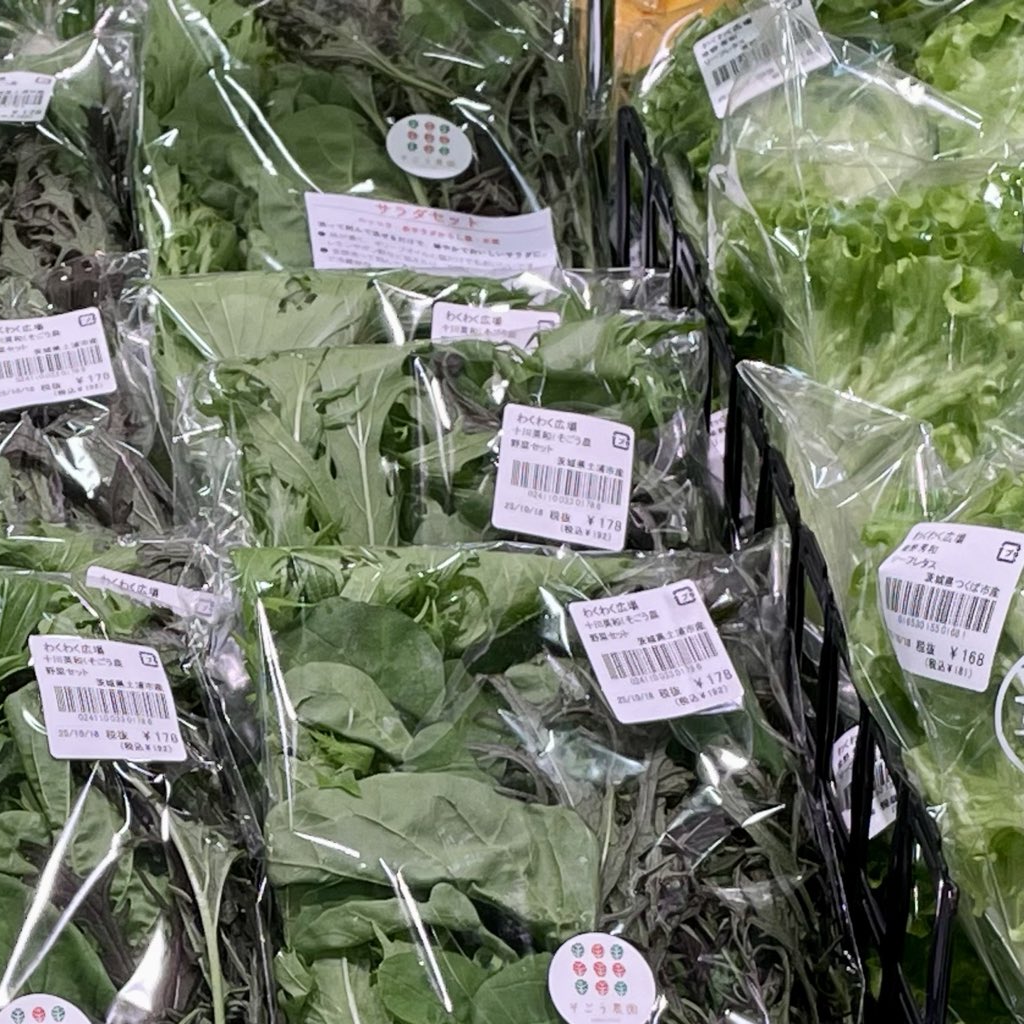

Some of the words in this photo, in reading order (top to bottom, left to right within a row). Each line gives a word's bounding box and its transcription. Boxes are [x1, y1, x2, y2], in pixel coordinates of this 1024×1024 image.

[376, 203, 481, 227] サラダセット
[518, 414, 577, 431] わくわく広場
[925, 572, 1000, 598] 茨城県つくば市産
[583, 601, 639, 617] わくわく広場
[45, 643, 104, 654] わくわく広場
